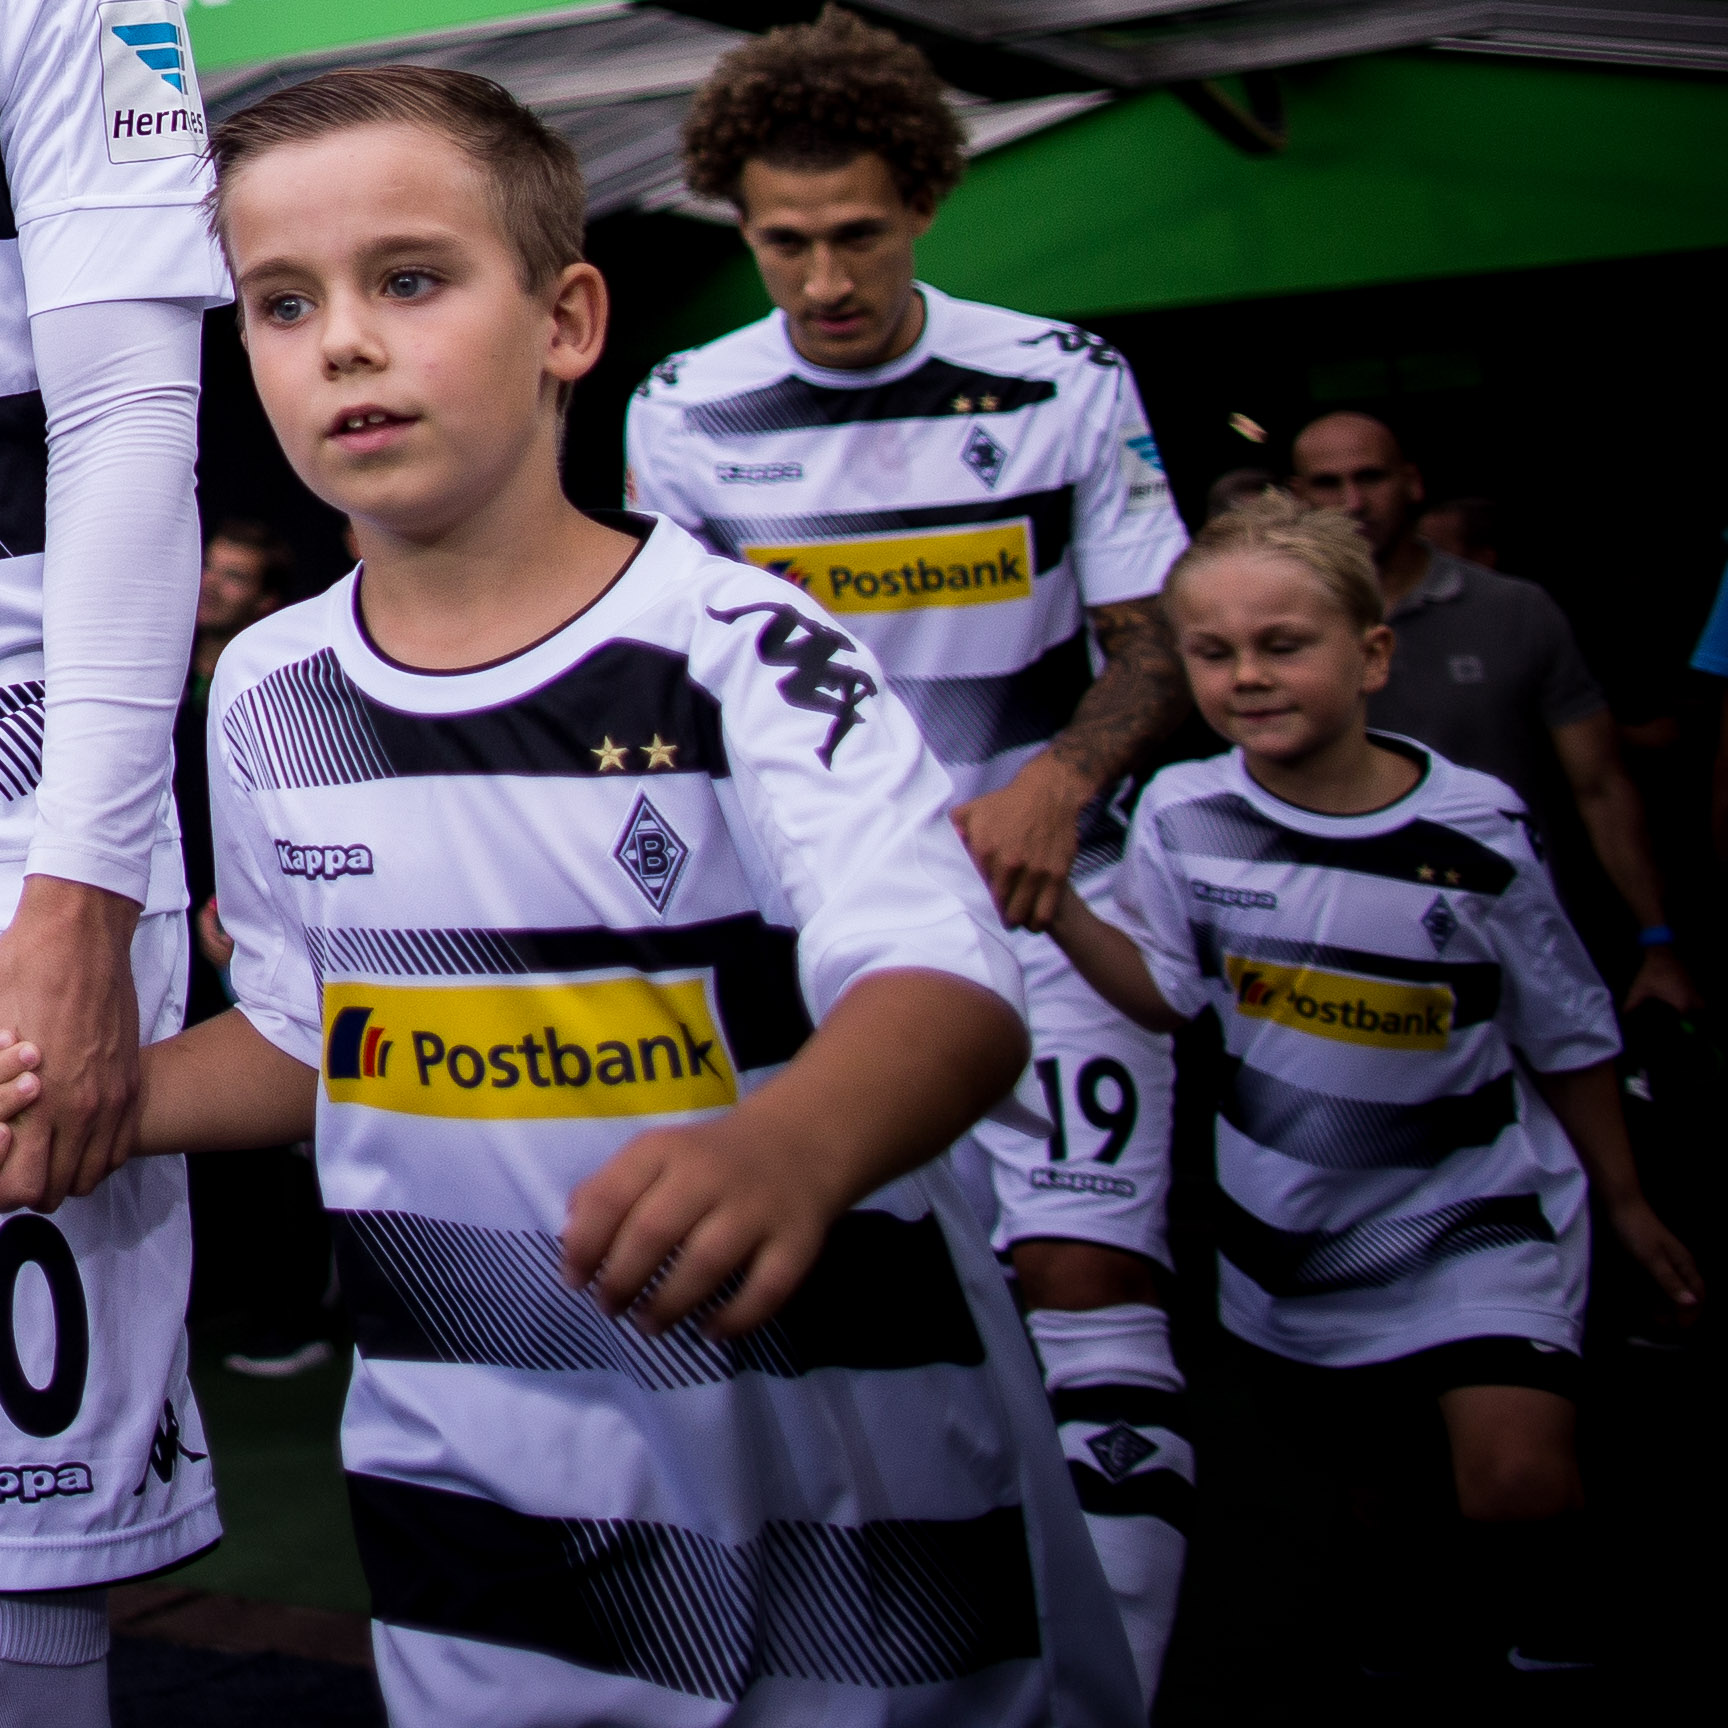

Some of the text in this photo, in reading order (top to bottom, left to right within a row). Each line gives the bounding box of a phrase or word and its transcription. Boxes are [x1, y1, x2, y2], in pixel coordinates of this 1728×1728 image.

[112, 107, 205, 139] Hermes
[829, 549, 1022, 600] Postbank
[275, 838, 374, 881] Kappa
[411, 1022, 726, 1091] Postbank
[1034, 1055, 1137, 1164] 19
